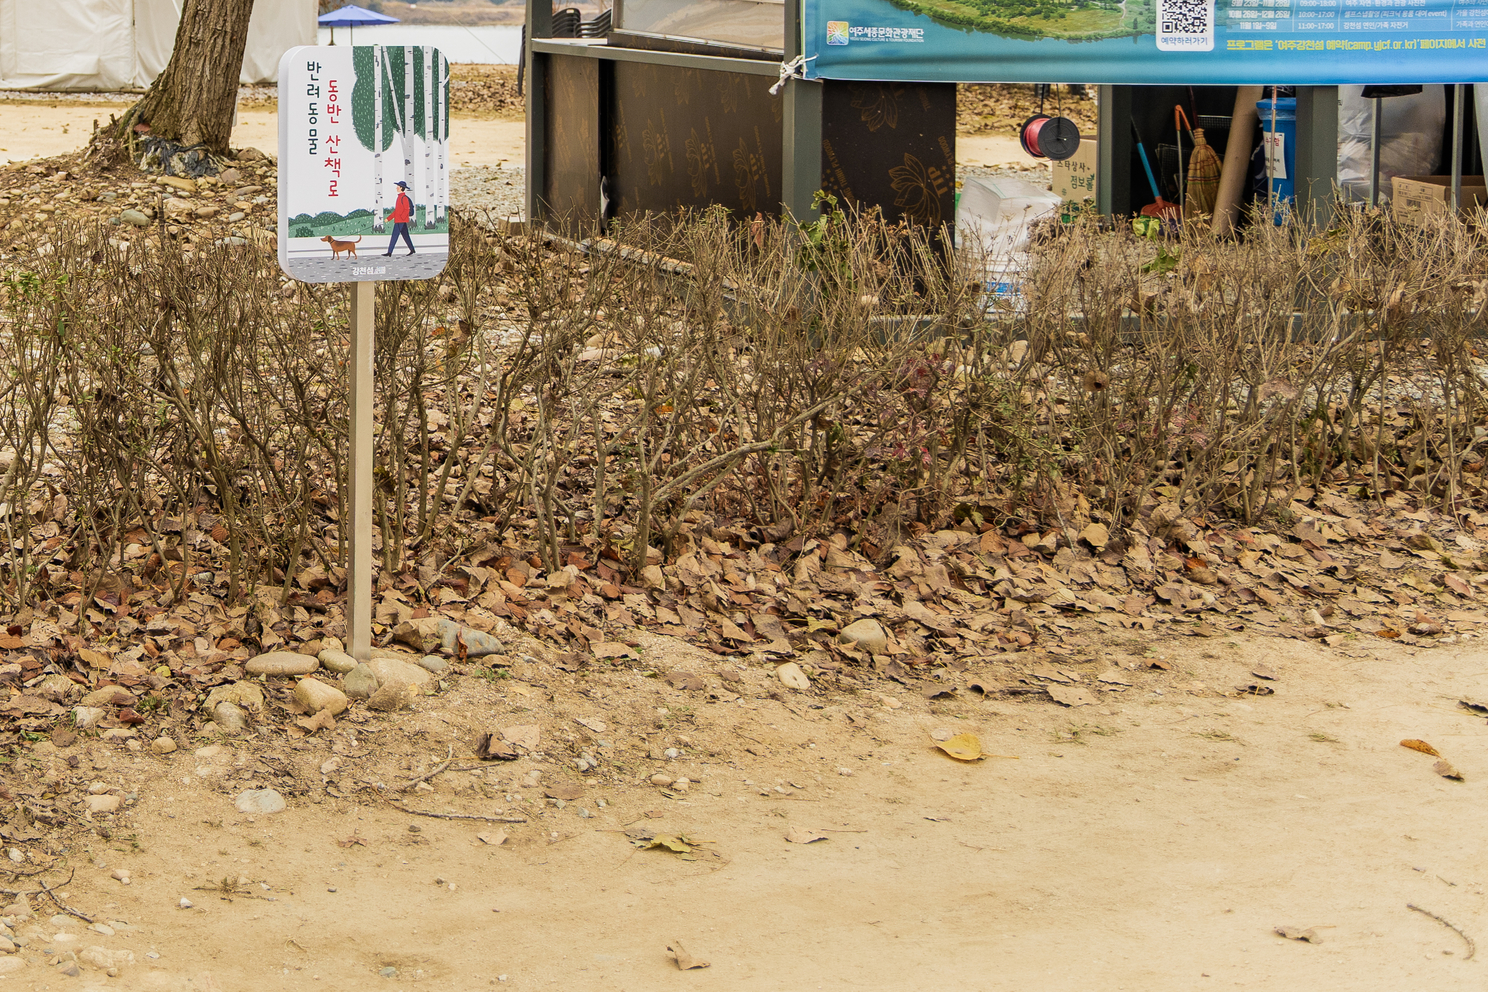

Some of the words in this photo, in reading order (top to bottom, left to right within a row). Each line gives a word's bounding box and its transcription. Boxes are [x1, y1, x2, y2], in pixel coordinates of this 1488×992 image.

[1298, 22, 1334, 30] 11:00~17:00
[849, 27, 924, 39] 여주세종문화관광재단
[1161, 37, 1208, 45] 예약하러가기
[1227, 40, 1273, 50] 프로그램은
[1468, 39, 1486, 49] 사전
[327, 79, 342, 124] 동반
[306, 60, 322, 155] 반려동물
[324, 134, 341, 197] 산책로
[352, 267, 373, 275] 강천섬
